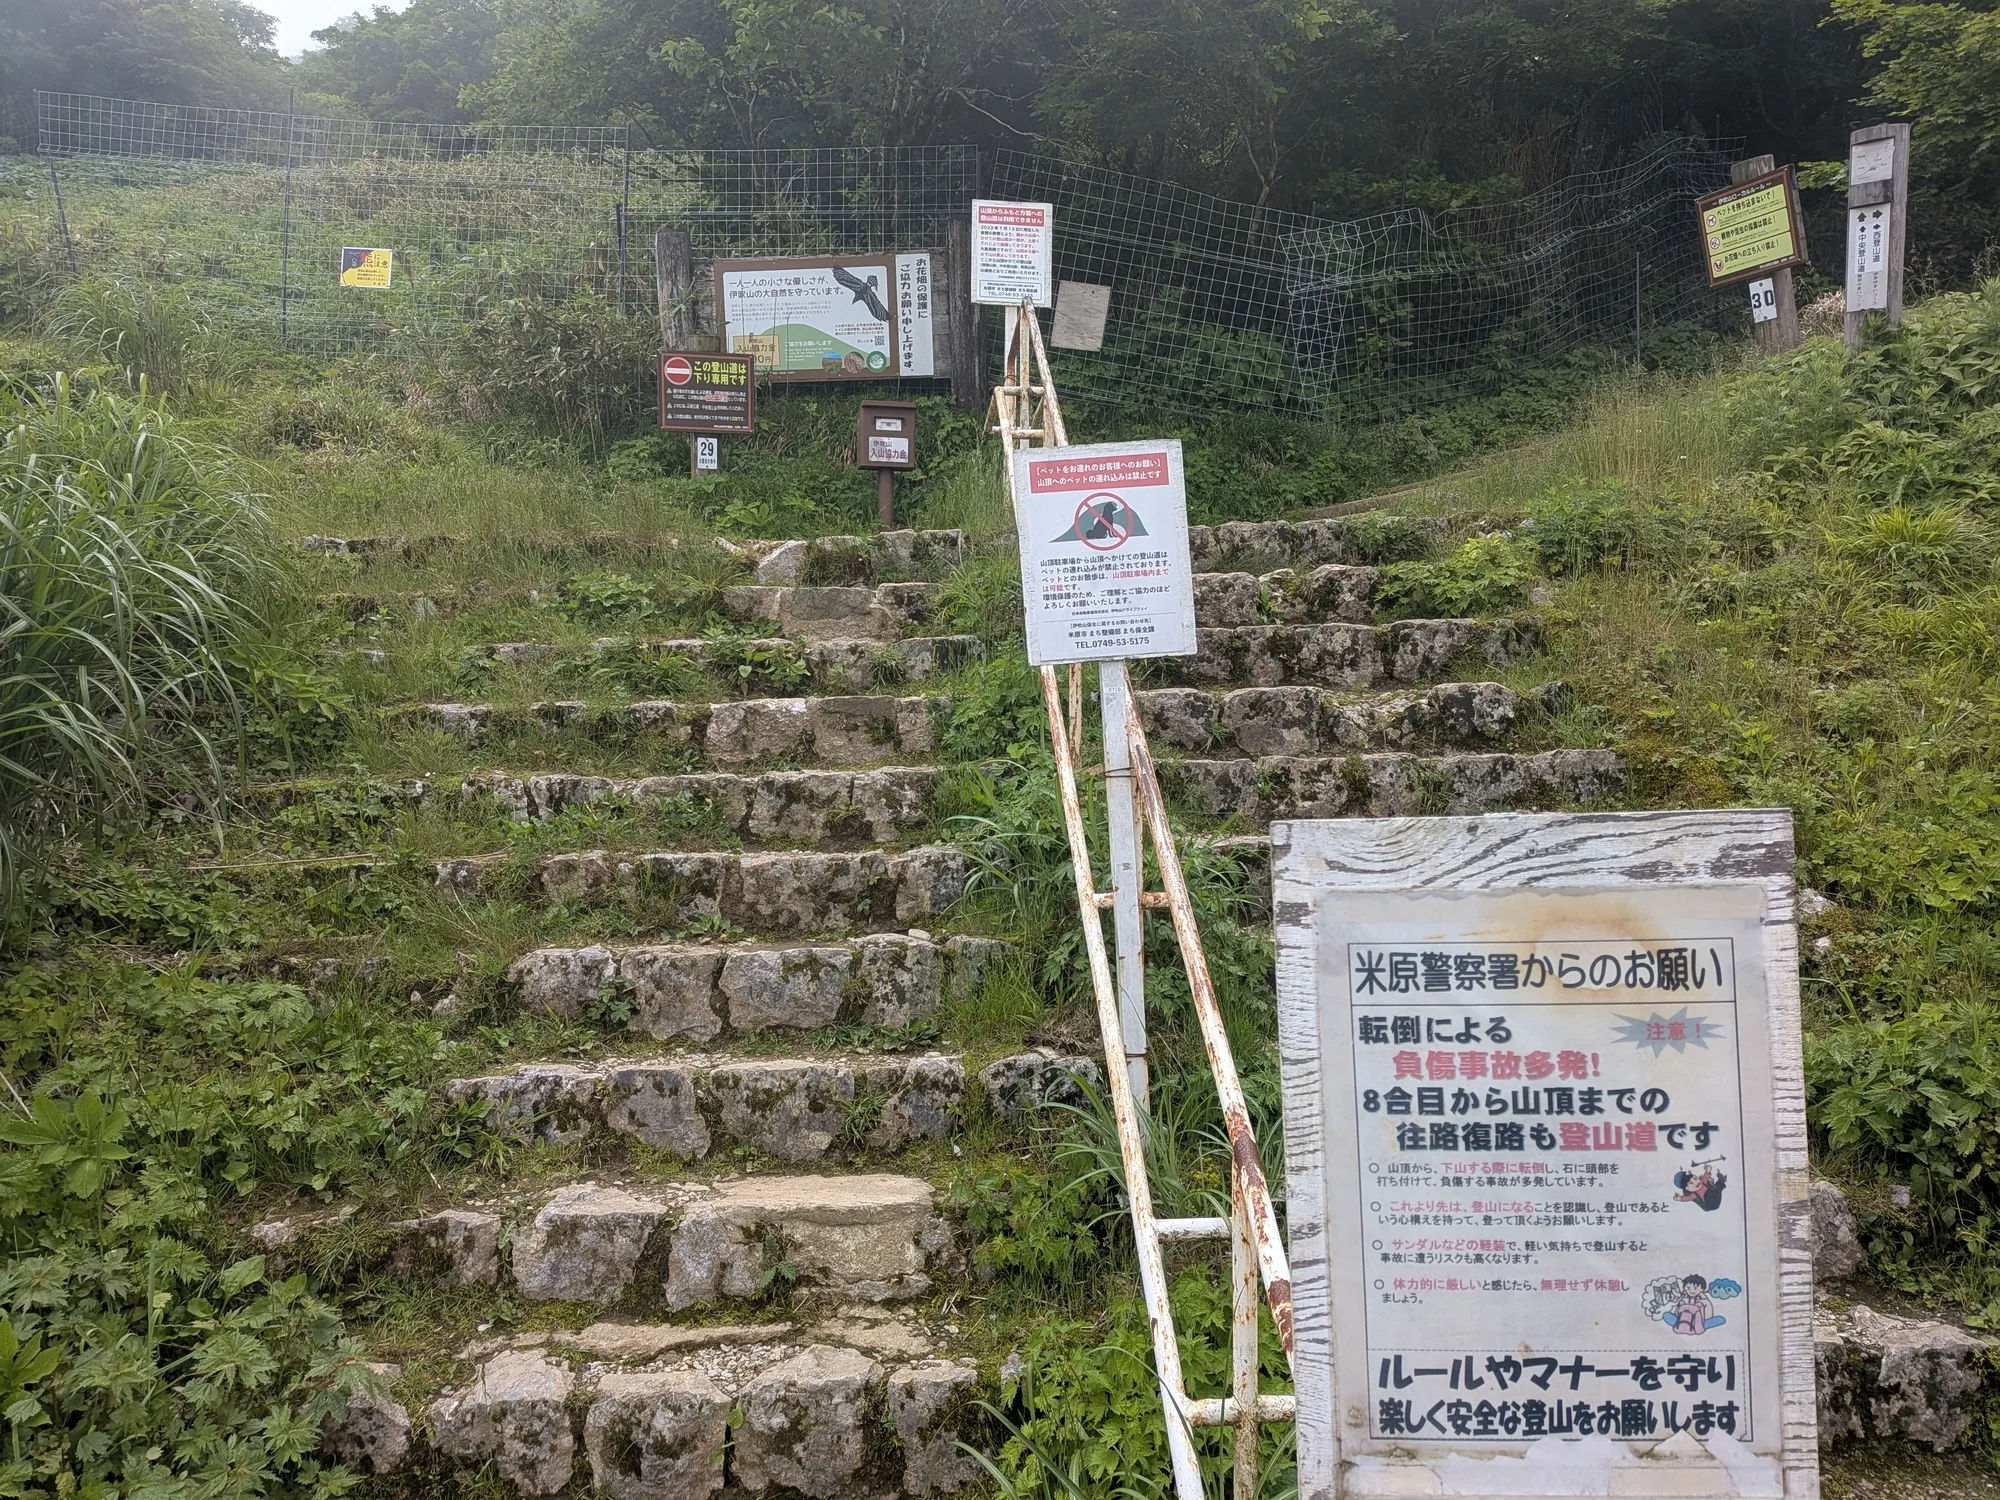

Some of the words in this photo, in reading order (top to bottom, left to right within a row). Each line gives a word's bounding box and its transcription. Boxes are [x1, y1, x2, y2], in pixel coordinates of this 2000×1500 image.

[1717, 190, 1775, 216] ペットを持ち込まないで！
[980, 208, 1042, 217] 山頂からふもと方面への
[980, 215, 1042, 224] 登山道は利用できません
[1857, 234, 1867, 273] 中央登山道
[1872, 231, 1881, 263] 西登山道
[729, 276, 829, 287] 一人一人の小さな優しさが、
[916, 258, 928, 319] お花畑の保護に
[729, 286, 844, 299] 伊吹山の大自然を守っています。
[1752, 290, 1774, 309] 30
[900, 264, 914, 372] ご協力お願い申し上げます。
[736, 344, 776, 353] 入山協力金
[694, 361, 747, 374] この登山道は
[693, 372, 747, 386] 下り専用です
[700, 441, 714, 456] 29
[873, 440, 892, 448] 伊吹山
[870, 448, 907, 460] 入山協力金
[1037, 470, 1161, 487] 山頂へのペットの連れ込みは禁止です
[1040, 551, 1168, 567] 山頂駐車場から山頂へかけての登山道は
[1041, 560, 1172, 575] ペットの連れ込みが禁止されております。
[1042, 569, 1169, 584] ペットとのお散歩は、山頂駐車場内まで
[1042, 584, 1081, 592] は可能です。
[1042, 585, 1171, 601] 環境保護のため、ご理解とご協力のほど
[1044, 597, 1132, 610] よろしくお願いいたします。
[1068, 631, 1087, 639] 米原市
[1089, 628, 1121, 637] まち整備部
[1123, 625, 1155, 635] まち保全課
[1075, 637, 1150, 649] TEL.0749-53-5175
[1355, 947, 1722, 995] 米原警察署からのお願い
[1358, 1015, 1512, 1045] 転倒による
[1646, 1021, 1702, 1041] 注意！
[1393, 1051, 1600, 1080] 負傷事故多発!
[1363, 1087, 1670, 1116] 8合目から山頂までの
[1396, 1121, 1719, 1151] 往路復路も登山道です
[1388, 1162, 1620, 1174] 山頂から、下山する際に転倒し、石に頭部を
[1377, 1175, 1604, 1187] 打ち付けて、負傷する事故が多発しています。
[1390, 1201, 1670, 1213] これより先は、登山になることを認識し、登山であると
[1378, 1214, 1623, 1226] いう心構えを持って、登って頂くようお願いします。
[1391, 1239, 1648, 1252] サンダルなどの軽装で、軽い気持ちで登山すると
[1380, 1252, 1539, 1264] 事故に遭うリスクも高くなります。
[1392, 1278, 1630, 1291] 体力的に厳しいと感じたら、無理せず休憩し
[1382, 1292, 1423, 1304] ましょう。
[1378, 1354, 1735, 1392] ルールやマナーを守り
[1378, 1398, 1739, 1437] 楽しく安全な登山をお願いします
